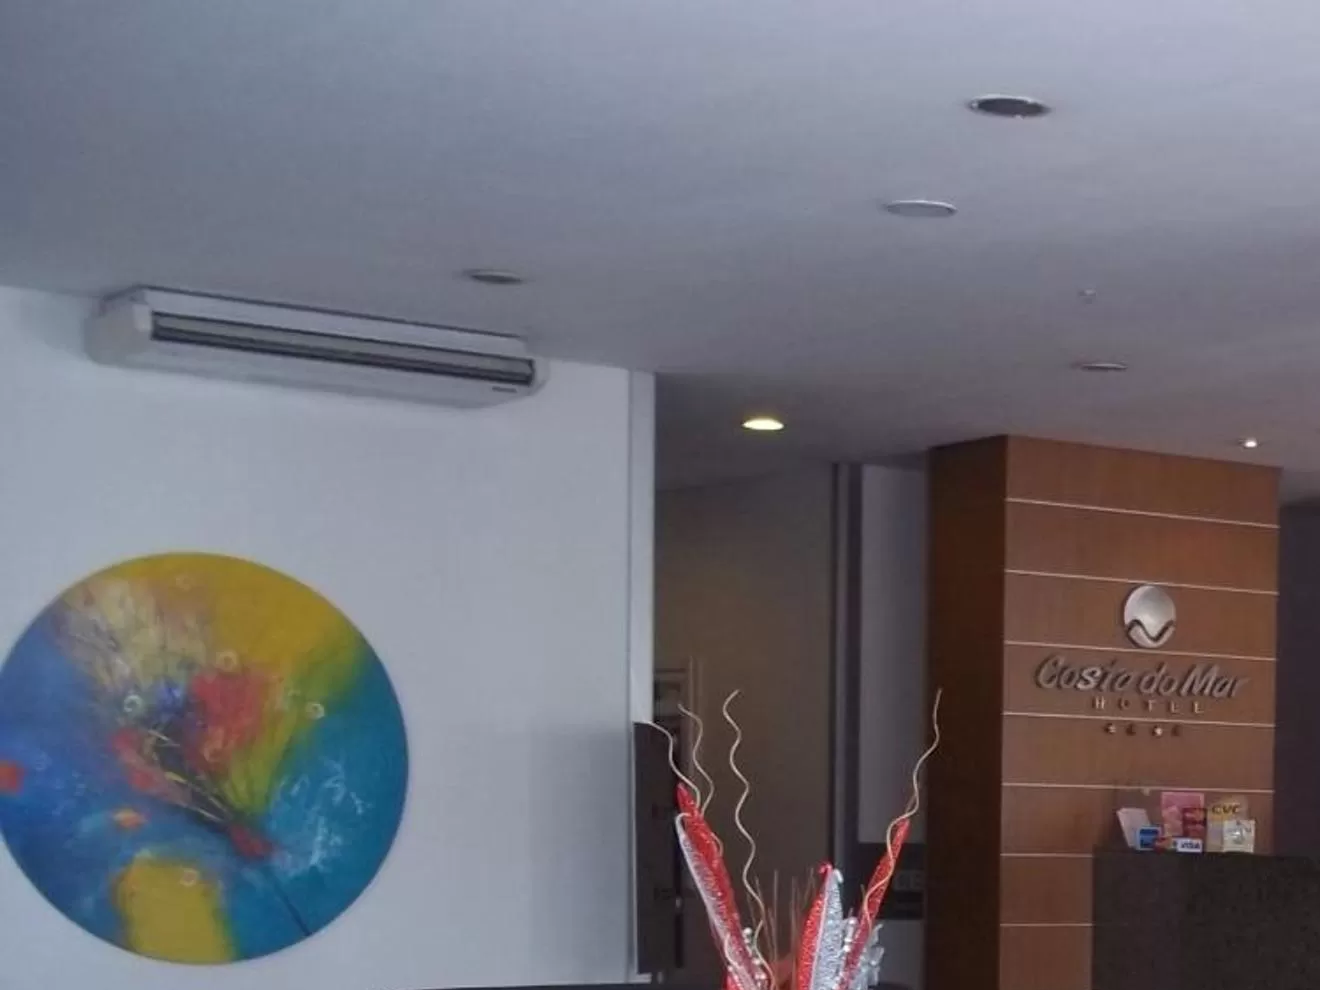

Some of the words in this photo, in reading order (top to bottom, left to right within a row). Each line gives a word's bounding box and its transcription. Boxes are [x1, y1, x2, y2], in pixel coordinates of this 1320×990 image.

[1138, 661, 1179, 697] do
[1179, 663, 1250, 698] Mar
[1093, 696, 1205, 714] HOTEL
